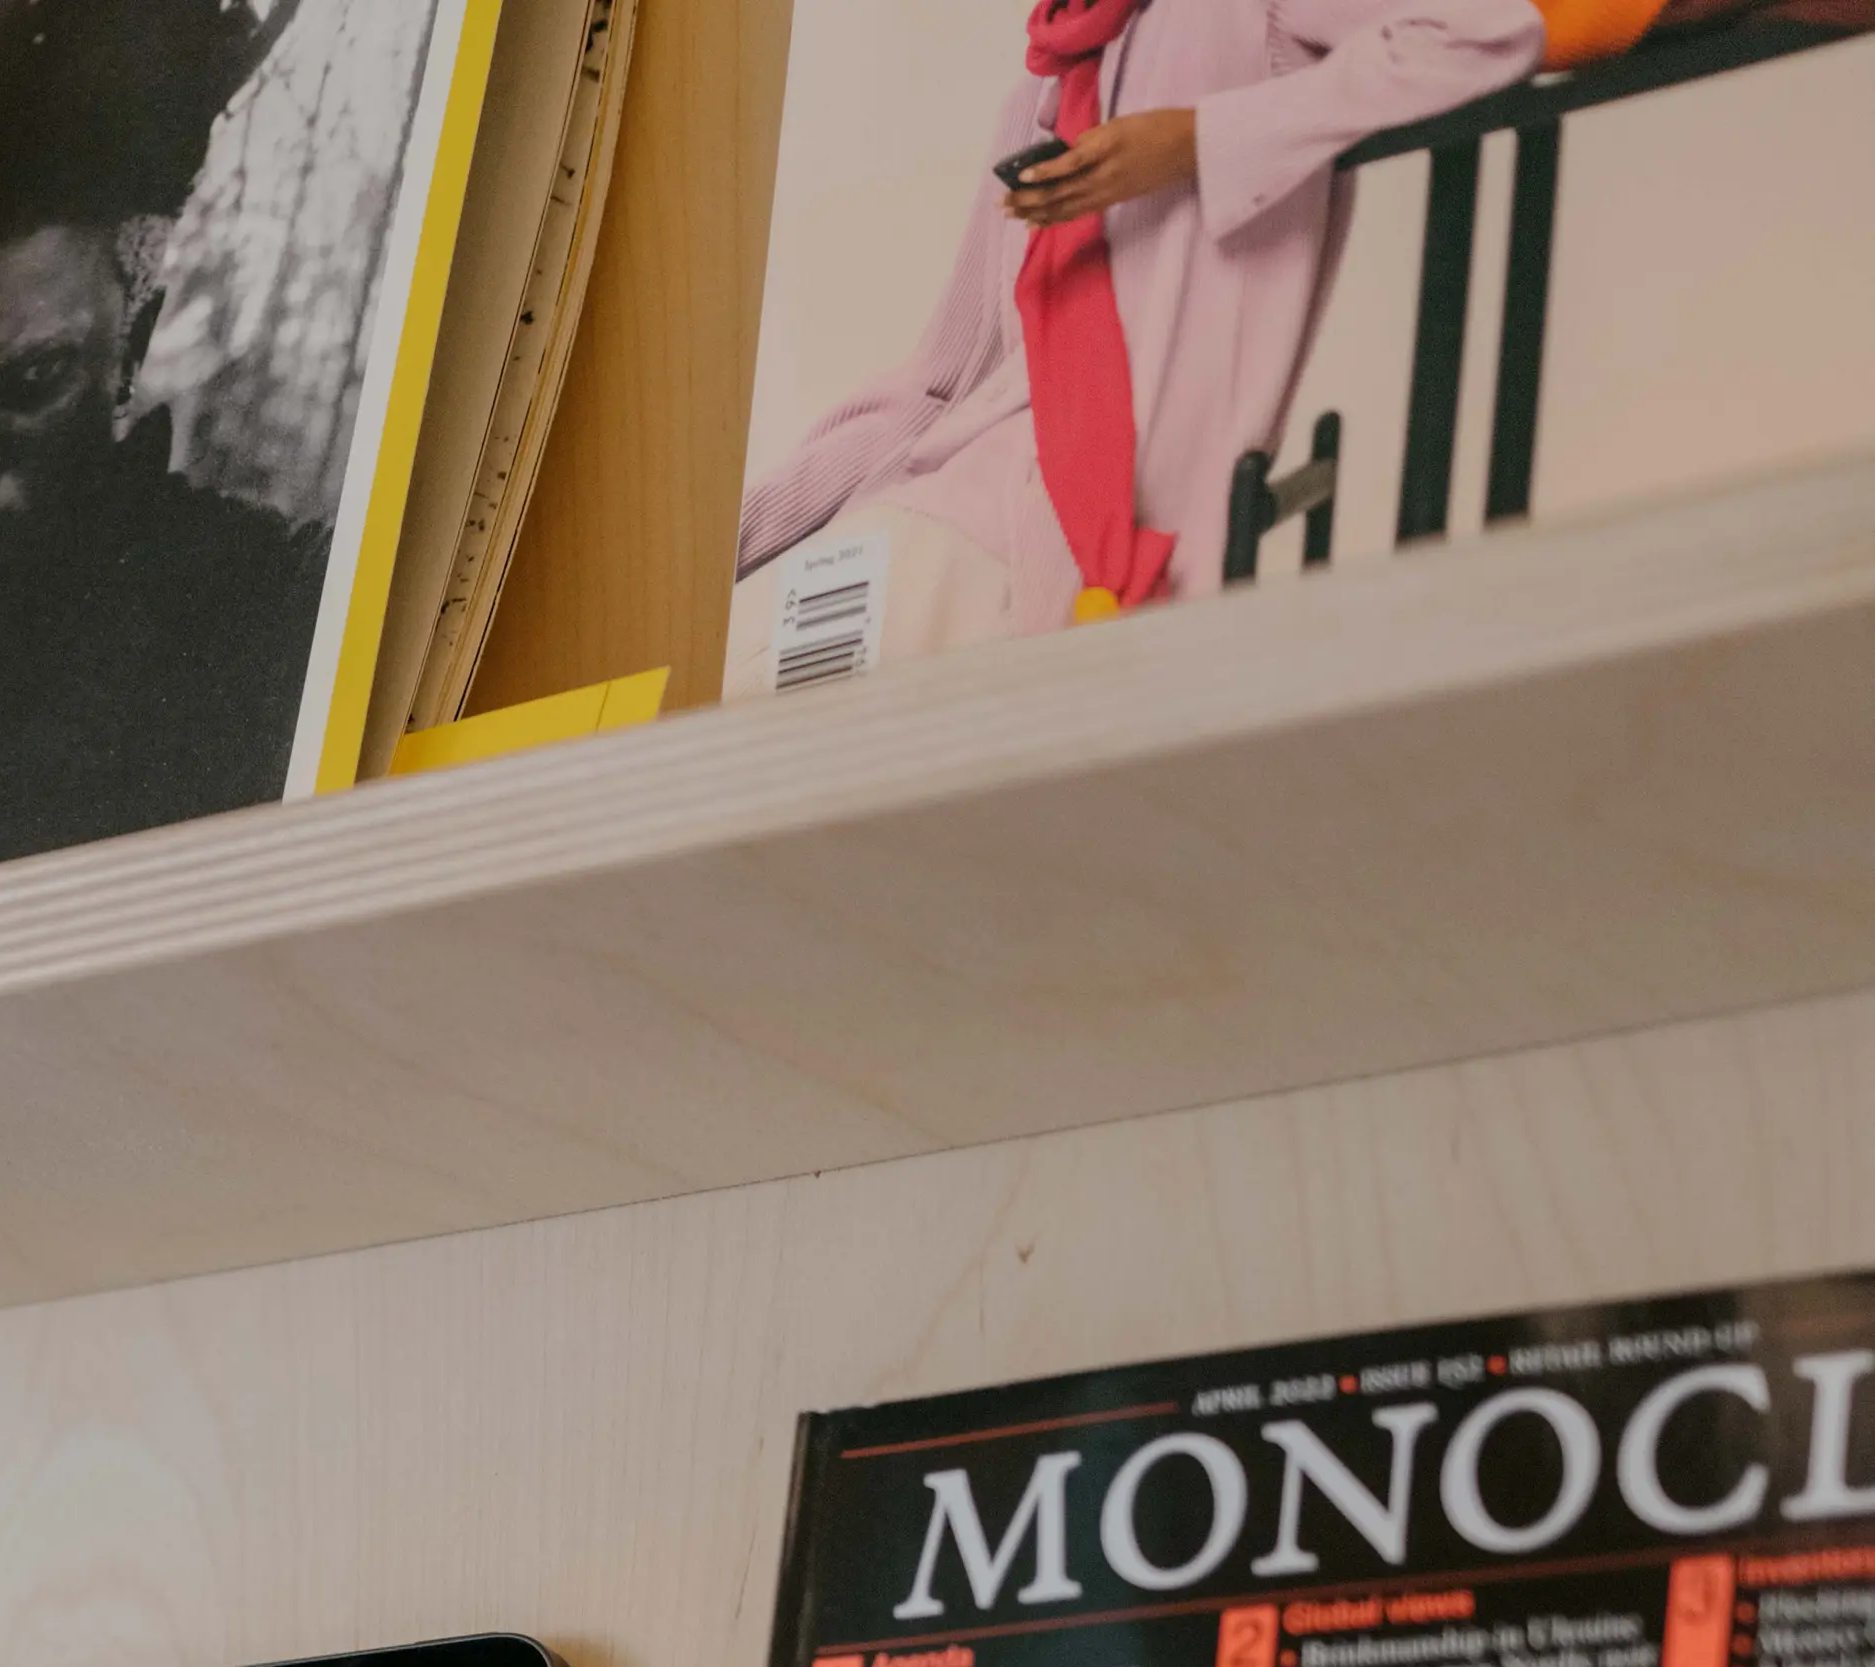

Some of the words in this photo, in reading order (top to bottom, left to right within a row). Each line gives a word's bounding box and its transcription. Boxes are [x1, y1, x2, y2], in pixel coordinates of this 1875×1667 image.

[893, 1350, 1875, 1619] MONOCL
[1282, 1595, 1383, 1635] Global
[1385, 1590, 1475, 1624] views
